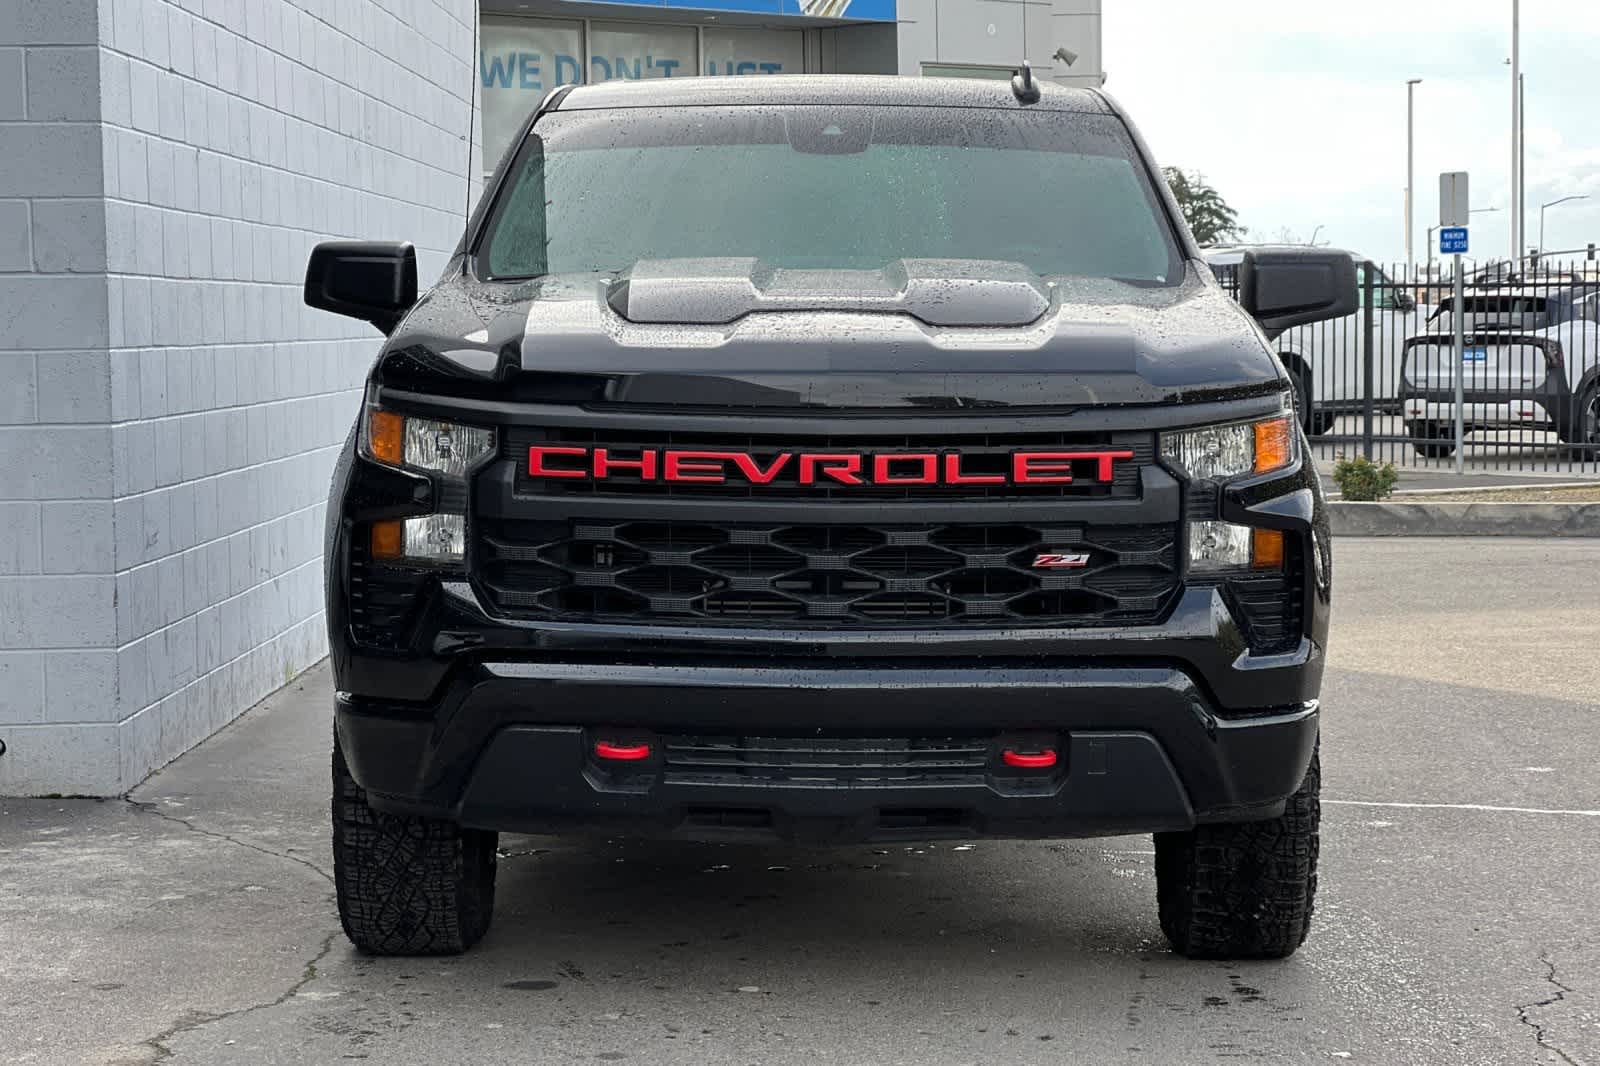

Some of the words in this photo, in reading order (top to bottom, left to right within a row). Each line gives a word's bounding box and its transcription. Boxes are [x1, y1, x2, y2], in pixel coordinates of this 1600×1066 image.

[480, 52, 542, 90] WE
[528, 445, 1134, 485] CHEVROLET
[1032, 553, 1090, 568] Z71
